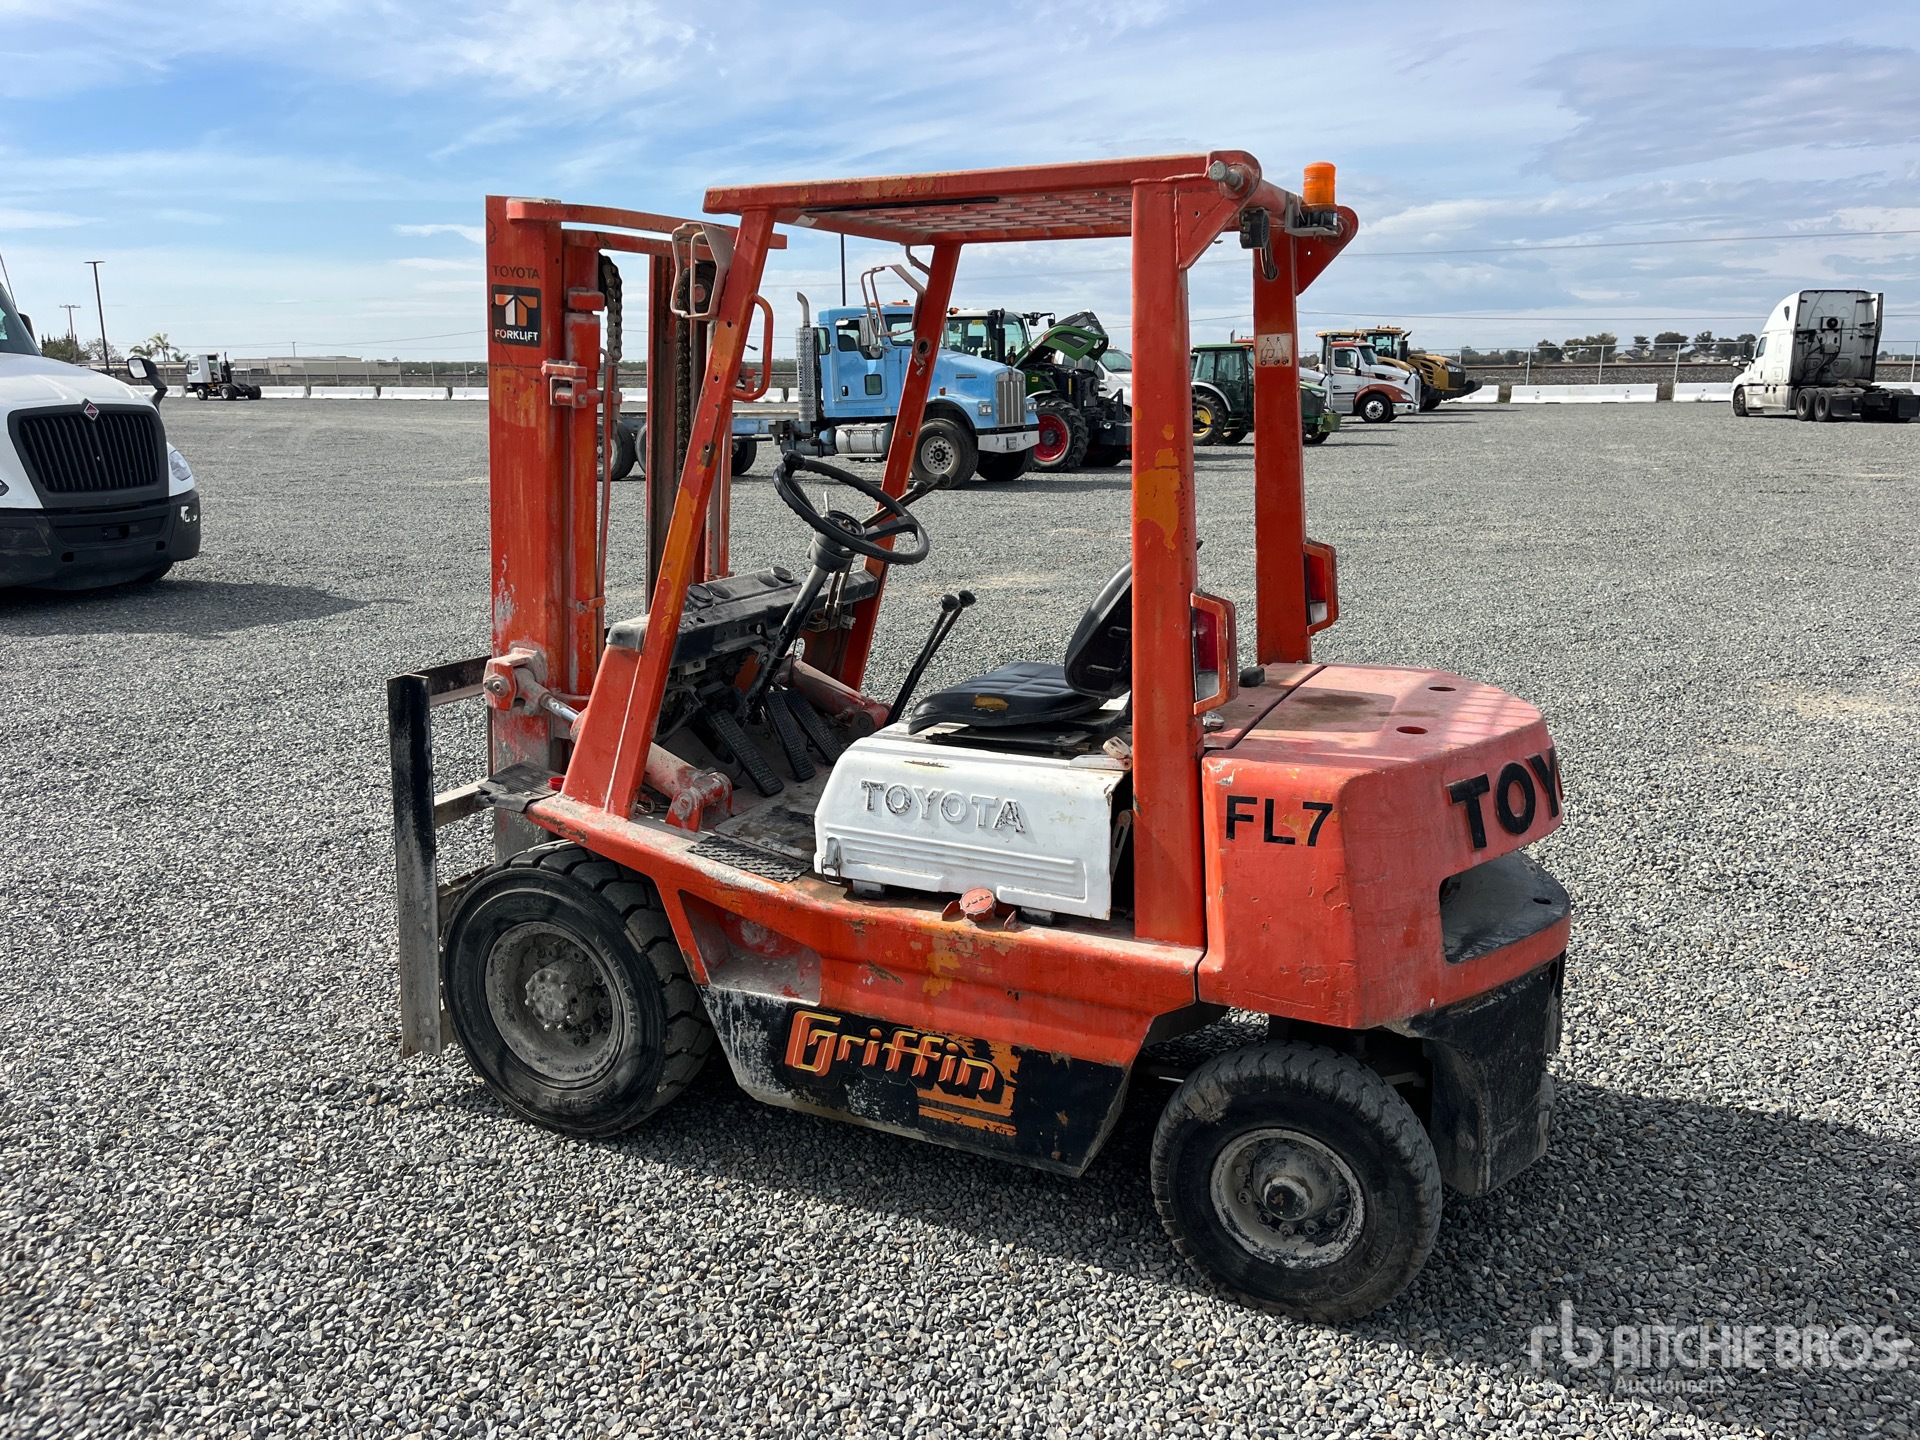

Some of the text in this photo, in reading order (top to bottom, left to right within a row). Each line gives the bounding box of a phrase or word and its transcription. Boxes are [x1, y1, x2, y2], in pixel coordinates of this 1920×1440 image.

[493, 265, 540, 279] TOYOTA
[494, 328, 539, 342] FORKLIFT
[860, 779, 1026, 834] TOYOTA
[1225, 794, 1334, 848] FL7
[784, 1010, 996, 1091] Griffin
